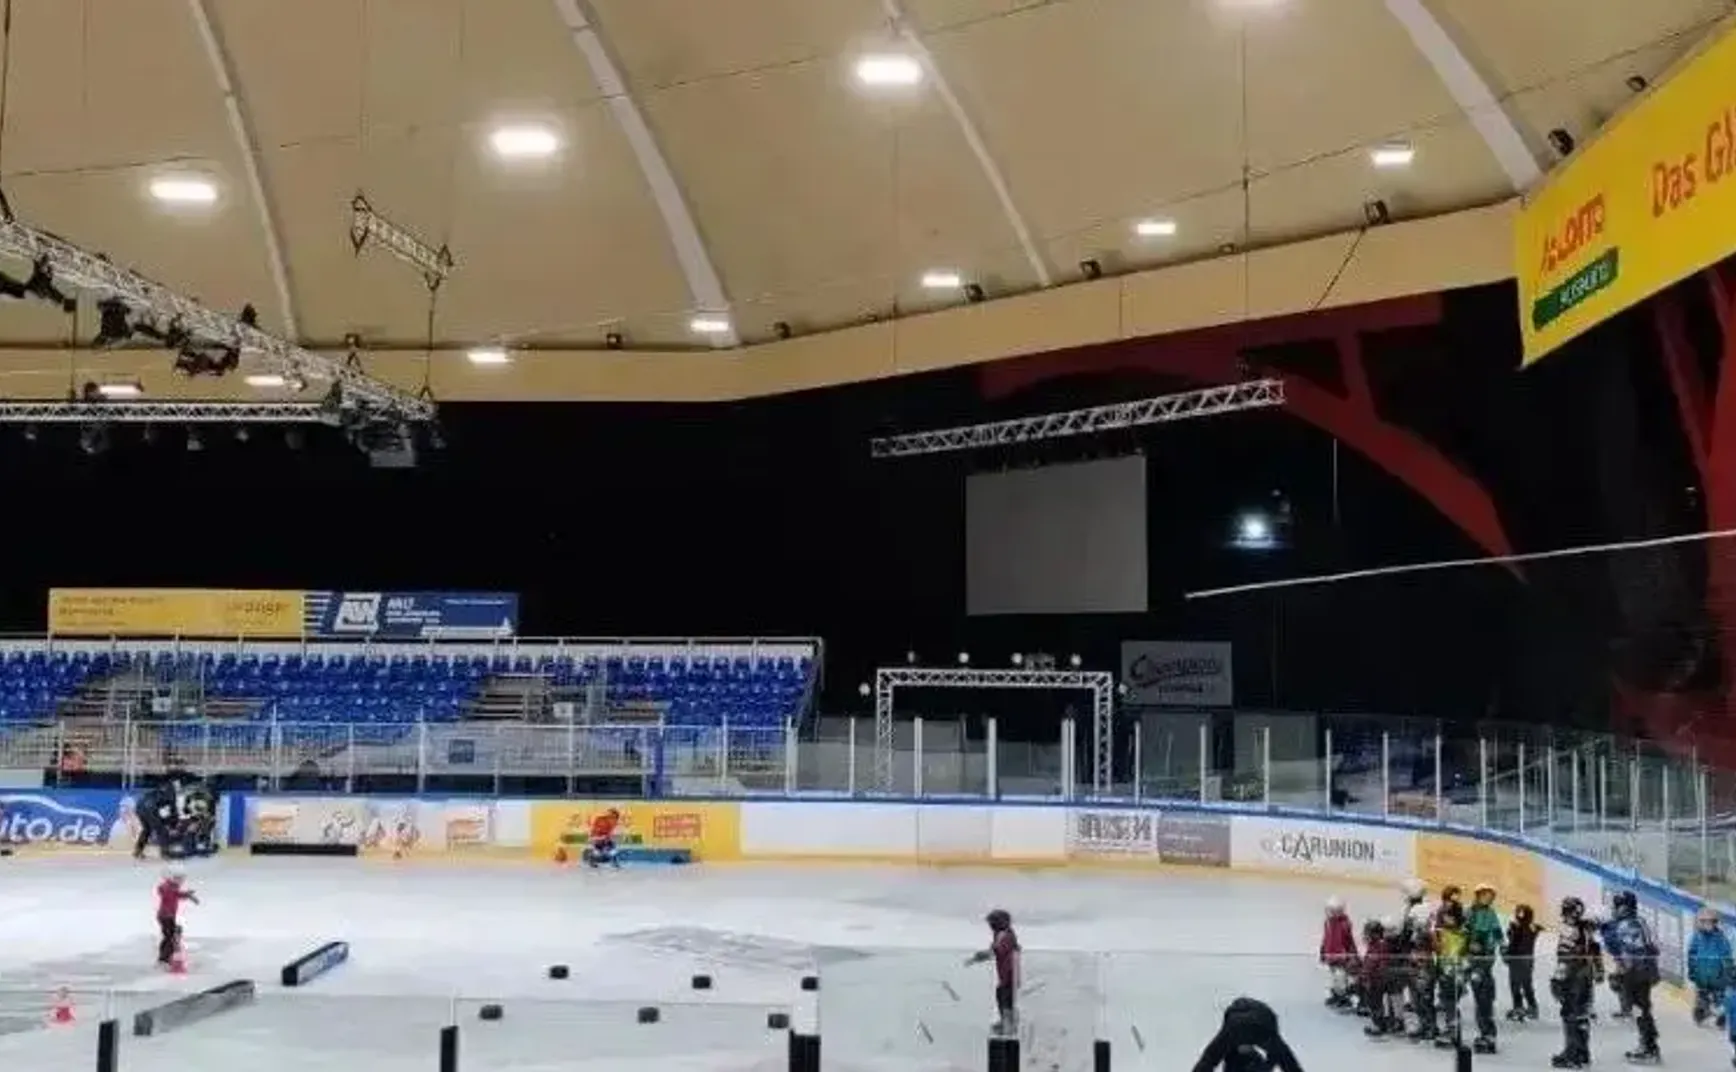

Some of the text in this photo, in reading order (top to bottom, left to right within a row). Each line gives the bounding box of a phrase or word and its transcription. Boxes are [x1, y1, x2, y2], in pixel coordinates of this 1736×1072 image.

[1652, 107, 1736, 219] Das Gl
[1281, 832, 1375, 863] CARUNION
